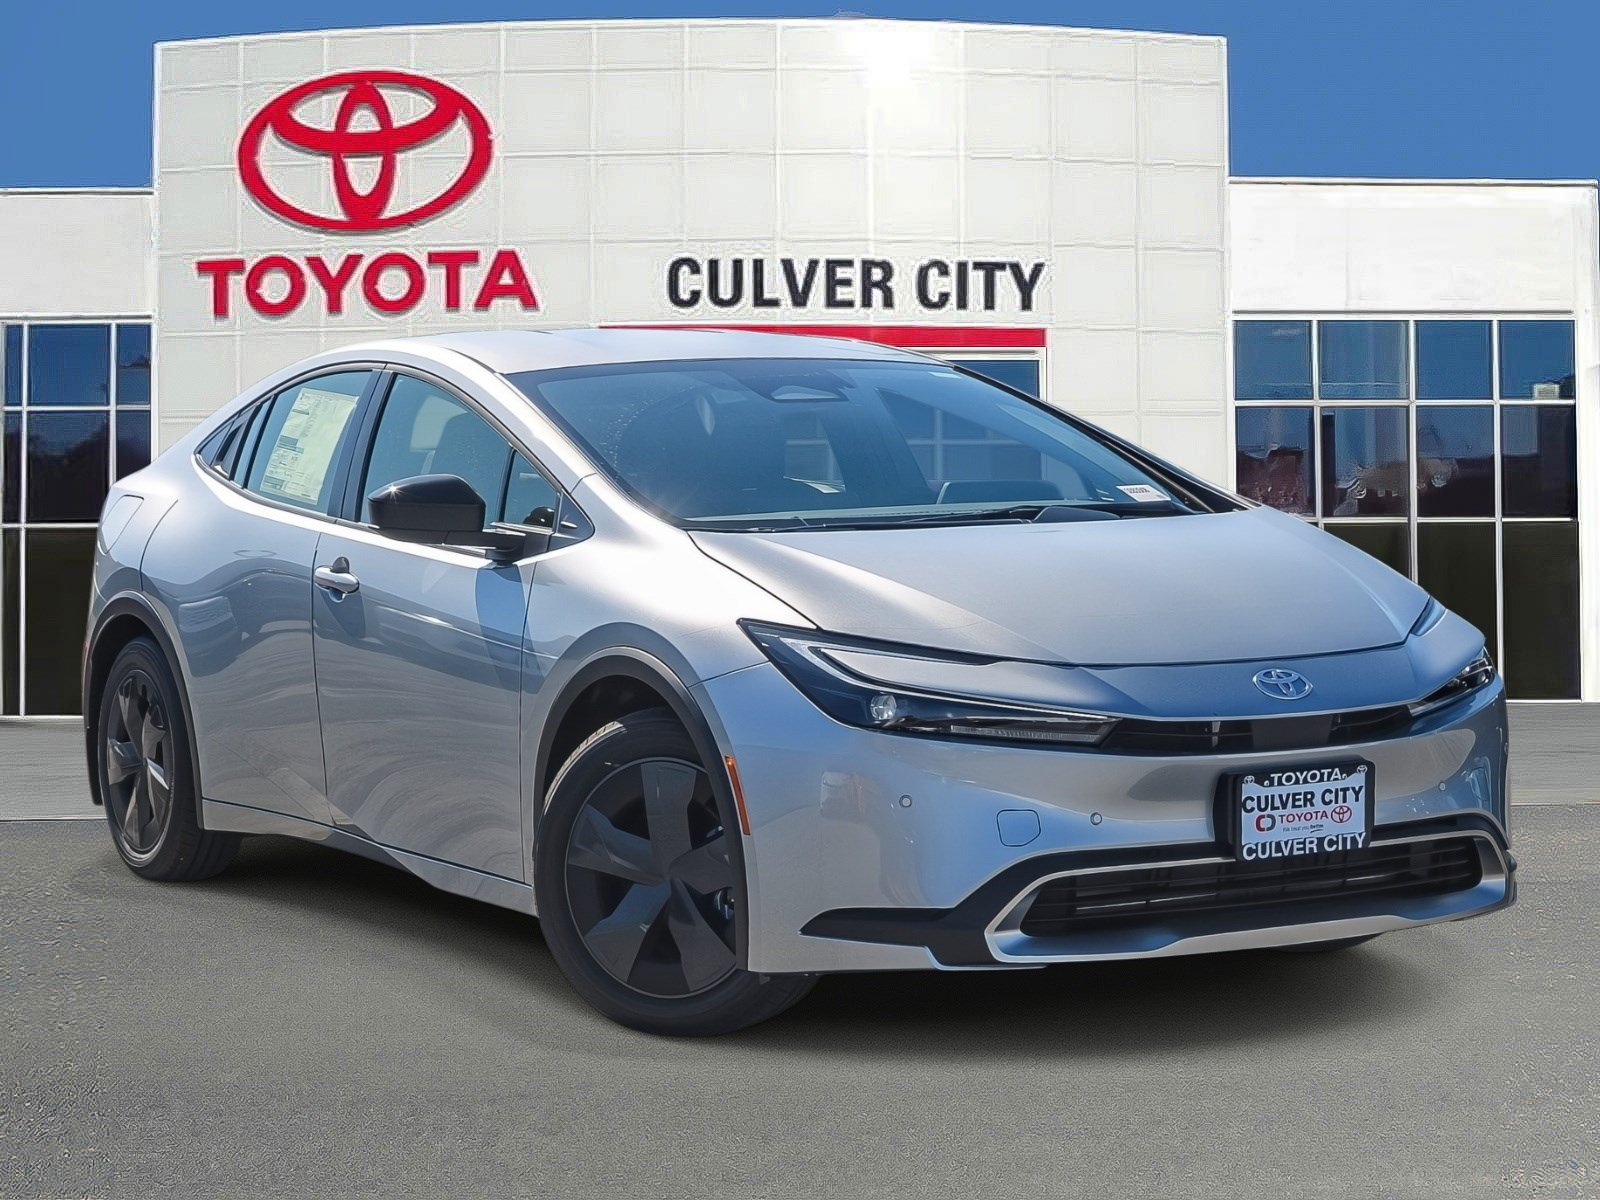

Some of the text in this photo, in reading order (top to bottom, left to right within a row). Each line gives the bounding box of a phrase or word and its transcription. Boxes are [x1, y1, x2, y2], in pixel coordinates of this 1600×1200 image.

[196, 248, 538, 318] TOYOTA
[667, 257, 1045, 311] CULVER CITY
[1270, 768, 1342, 786] TOYOTA
[1242, 785, 1364, 813] CULVER CITY
[1278, 810, 1329, 824] TOYOTA
[1243, 832, 1366, 861] CULVER CITY
